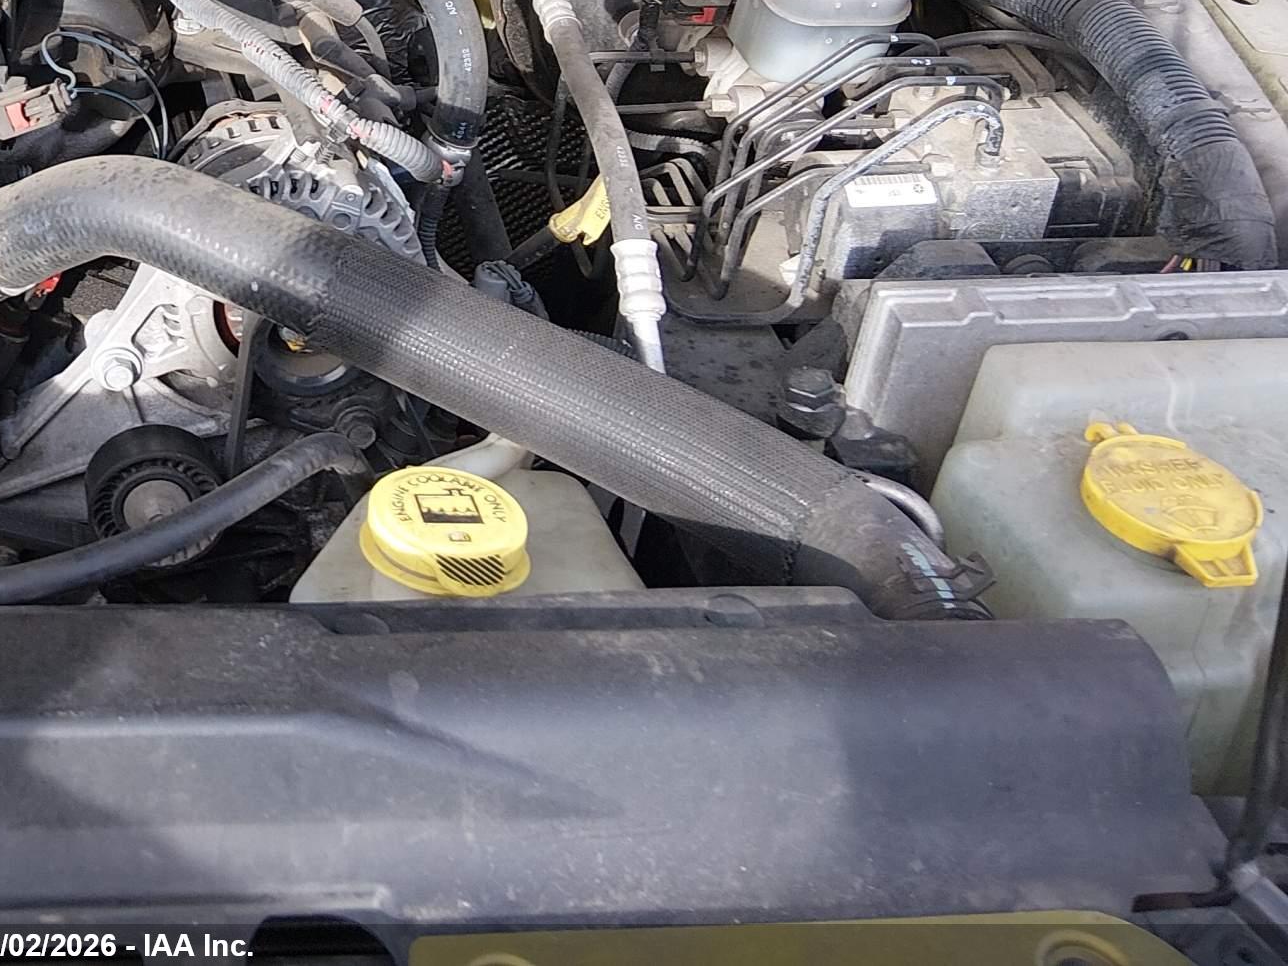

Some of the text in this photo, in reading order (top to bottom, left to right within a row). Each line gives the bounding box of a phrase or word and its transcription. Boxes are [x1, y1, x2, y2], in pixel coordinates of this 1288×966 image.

[1102, 457, 1204, 478] WASHER
[1100, 472, 1226, 494] FLUID ONLY
[392, 473, 507, 523] ENGINE COOLANT ONLY
